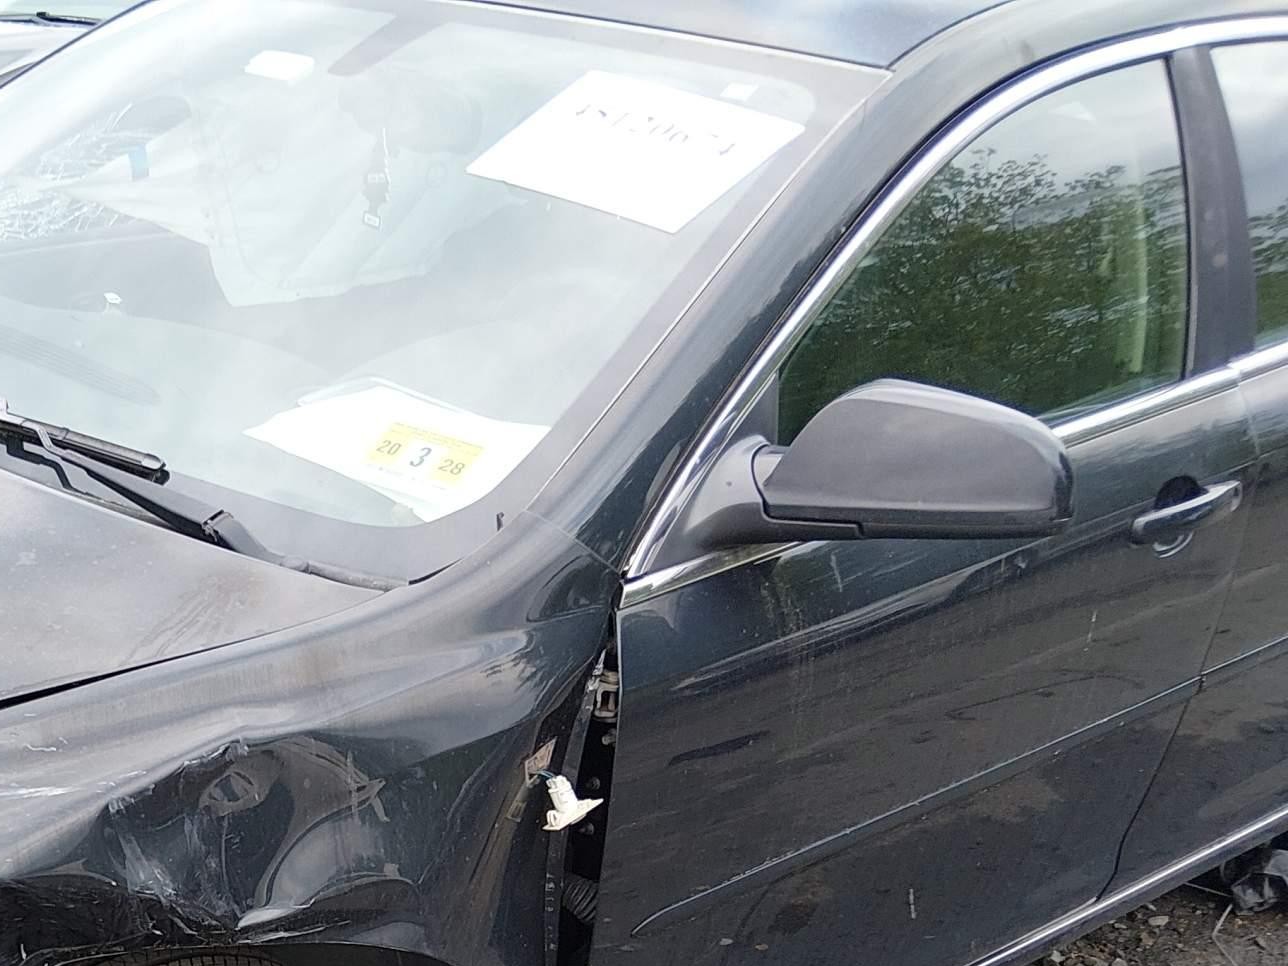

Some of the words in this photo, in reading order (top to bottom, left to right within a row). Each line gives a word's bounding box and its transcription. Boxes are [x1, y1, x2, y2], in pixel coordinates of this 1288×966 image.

[376, 439, 402, 456] 20
[409, 446, 433, 468] 3
[437, 458, 466, 476] 28
